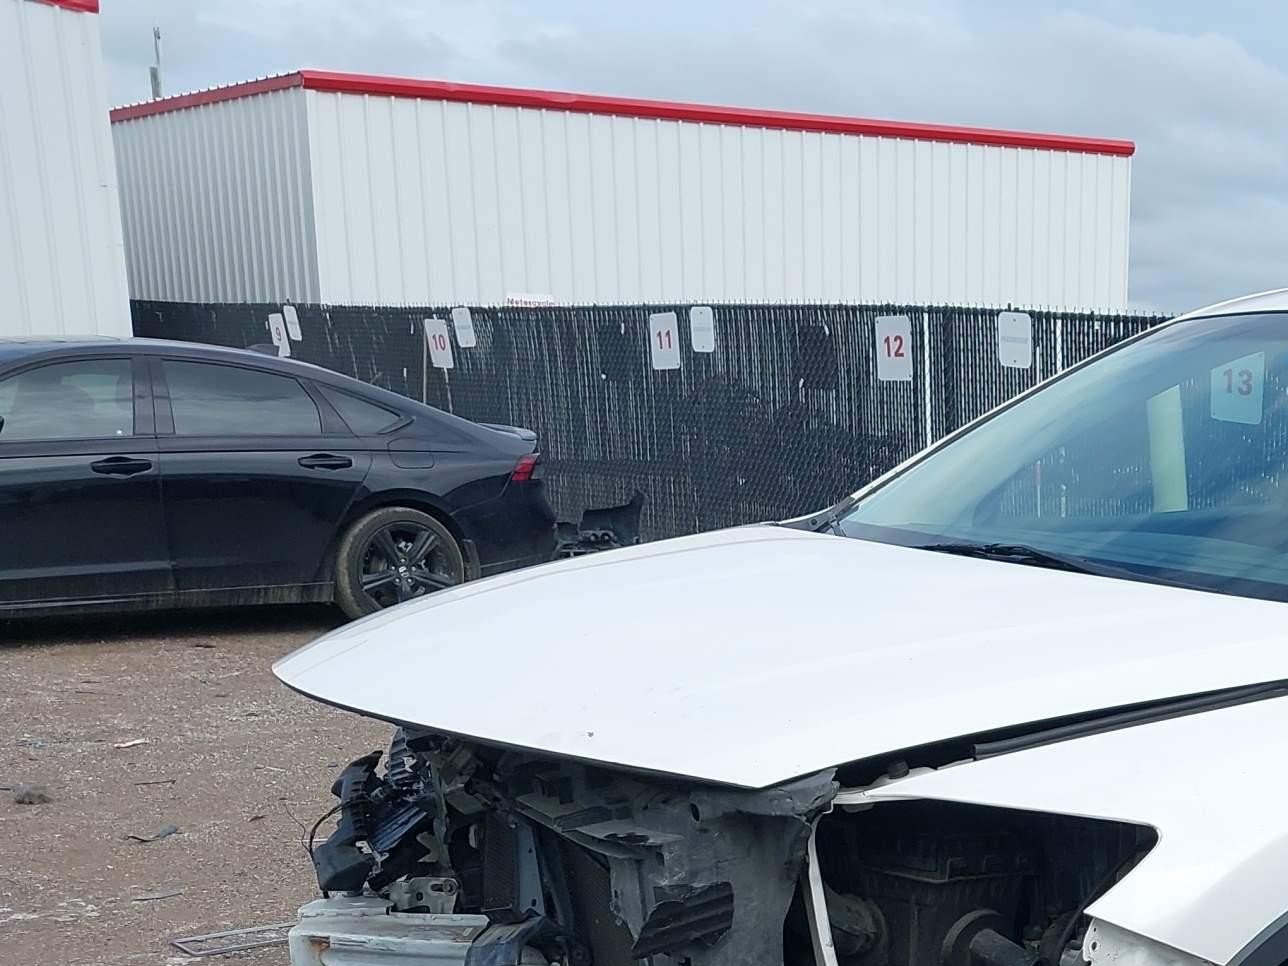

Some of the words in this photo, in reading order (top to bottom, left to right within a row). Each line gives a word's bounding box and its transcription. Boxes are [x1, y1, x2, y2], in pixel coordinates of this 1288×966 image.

[433, 334, 446, 350] 10
[656, 329, 672, 349] 11
[884, 335, 904, 357] 12
[1223, 369, 1253, 395] 13
